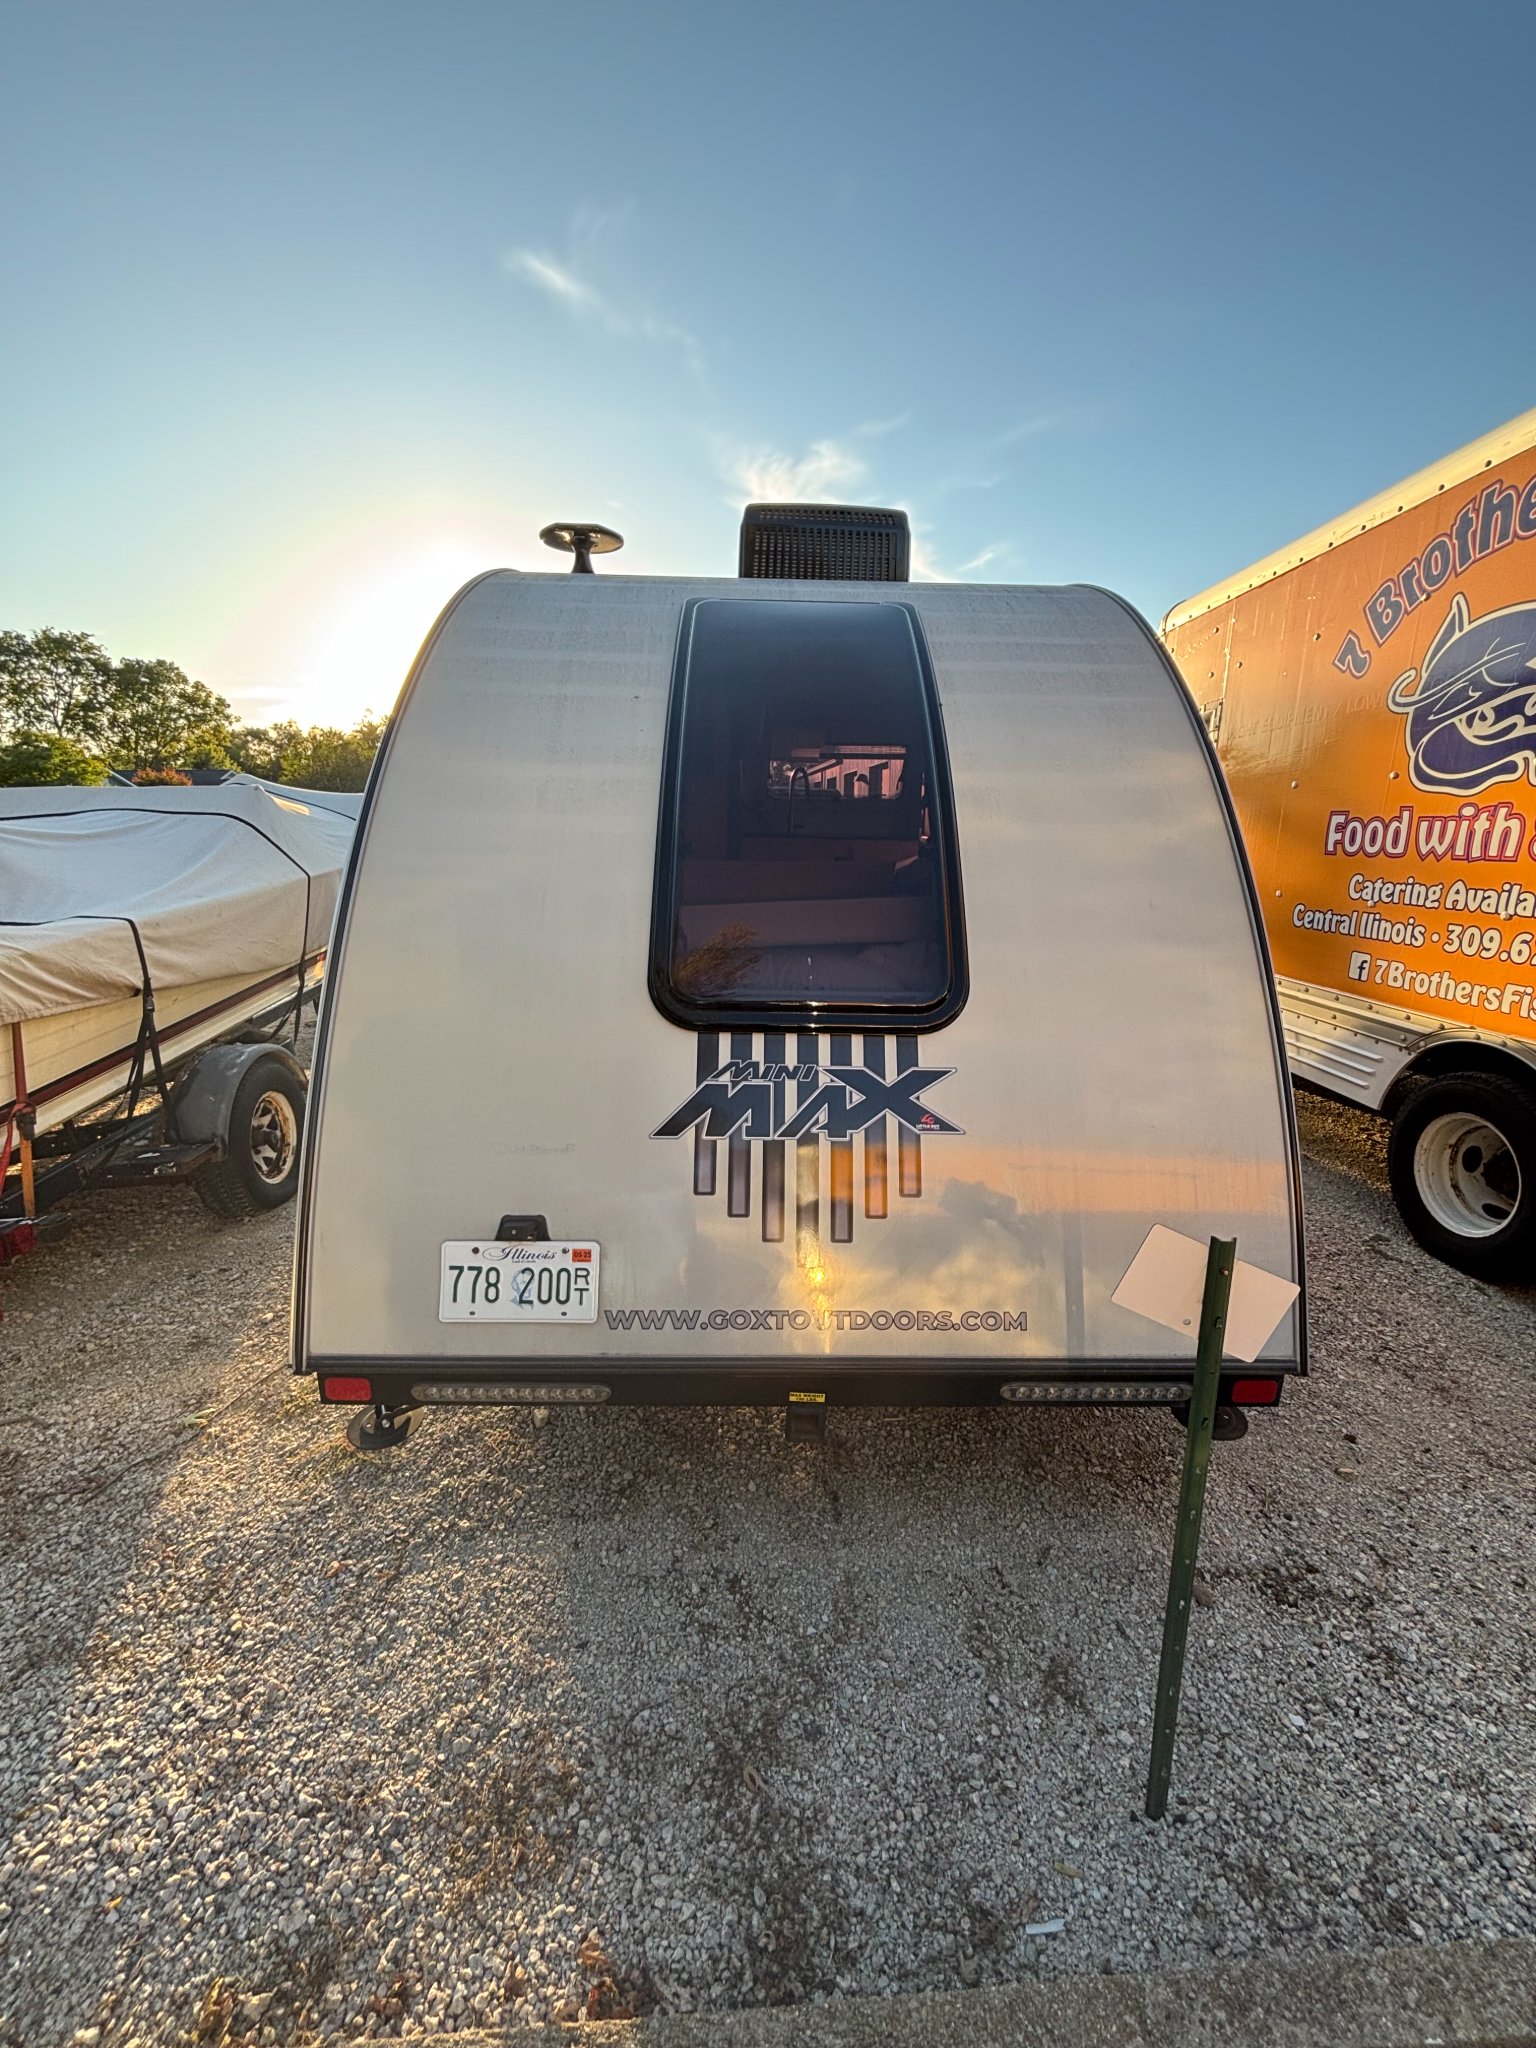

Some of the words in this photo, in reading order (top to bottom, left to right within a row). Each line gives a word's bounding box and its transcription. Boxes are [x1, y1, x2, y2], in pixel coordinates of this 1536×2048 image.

[1332, 629, 1371, 679] 7
[1325, 806, 1413, 856] Food
[1416, 802, 1526, 863] with
[1348, 873, 1444, 910] Catering
[1445, 879, 1536, 918] Availa
[1292, 903, 1358, 936] Central
[1442, 923, 1536, 966] 309.6
[709, 1059, 817, 1081] MINI
[649, 1065, 966, 1142] MAX
[482, 1246, 557, 1261] Illinois
[449, 1265, 500, 1303] 778
[518, 1267, 571, 1305] 200
[604, 1309, 1028, 1331] WWW.GOXTOUTDOORS.COM
